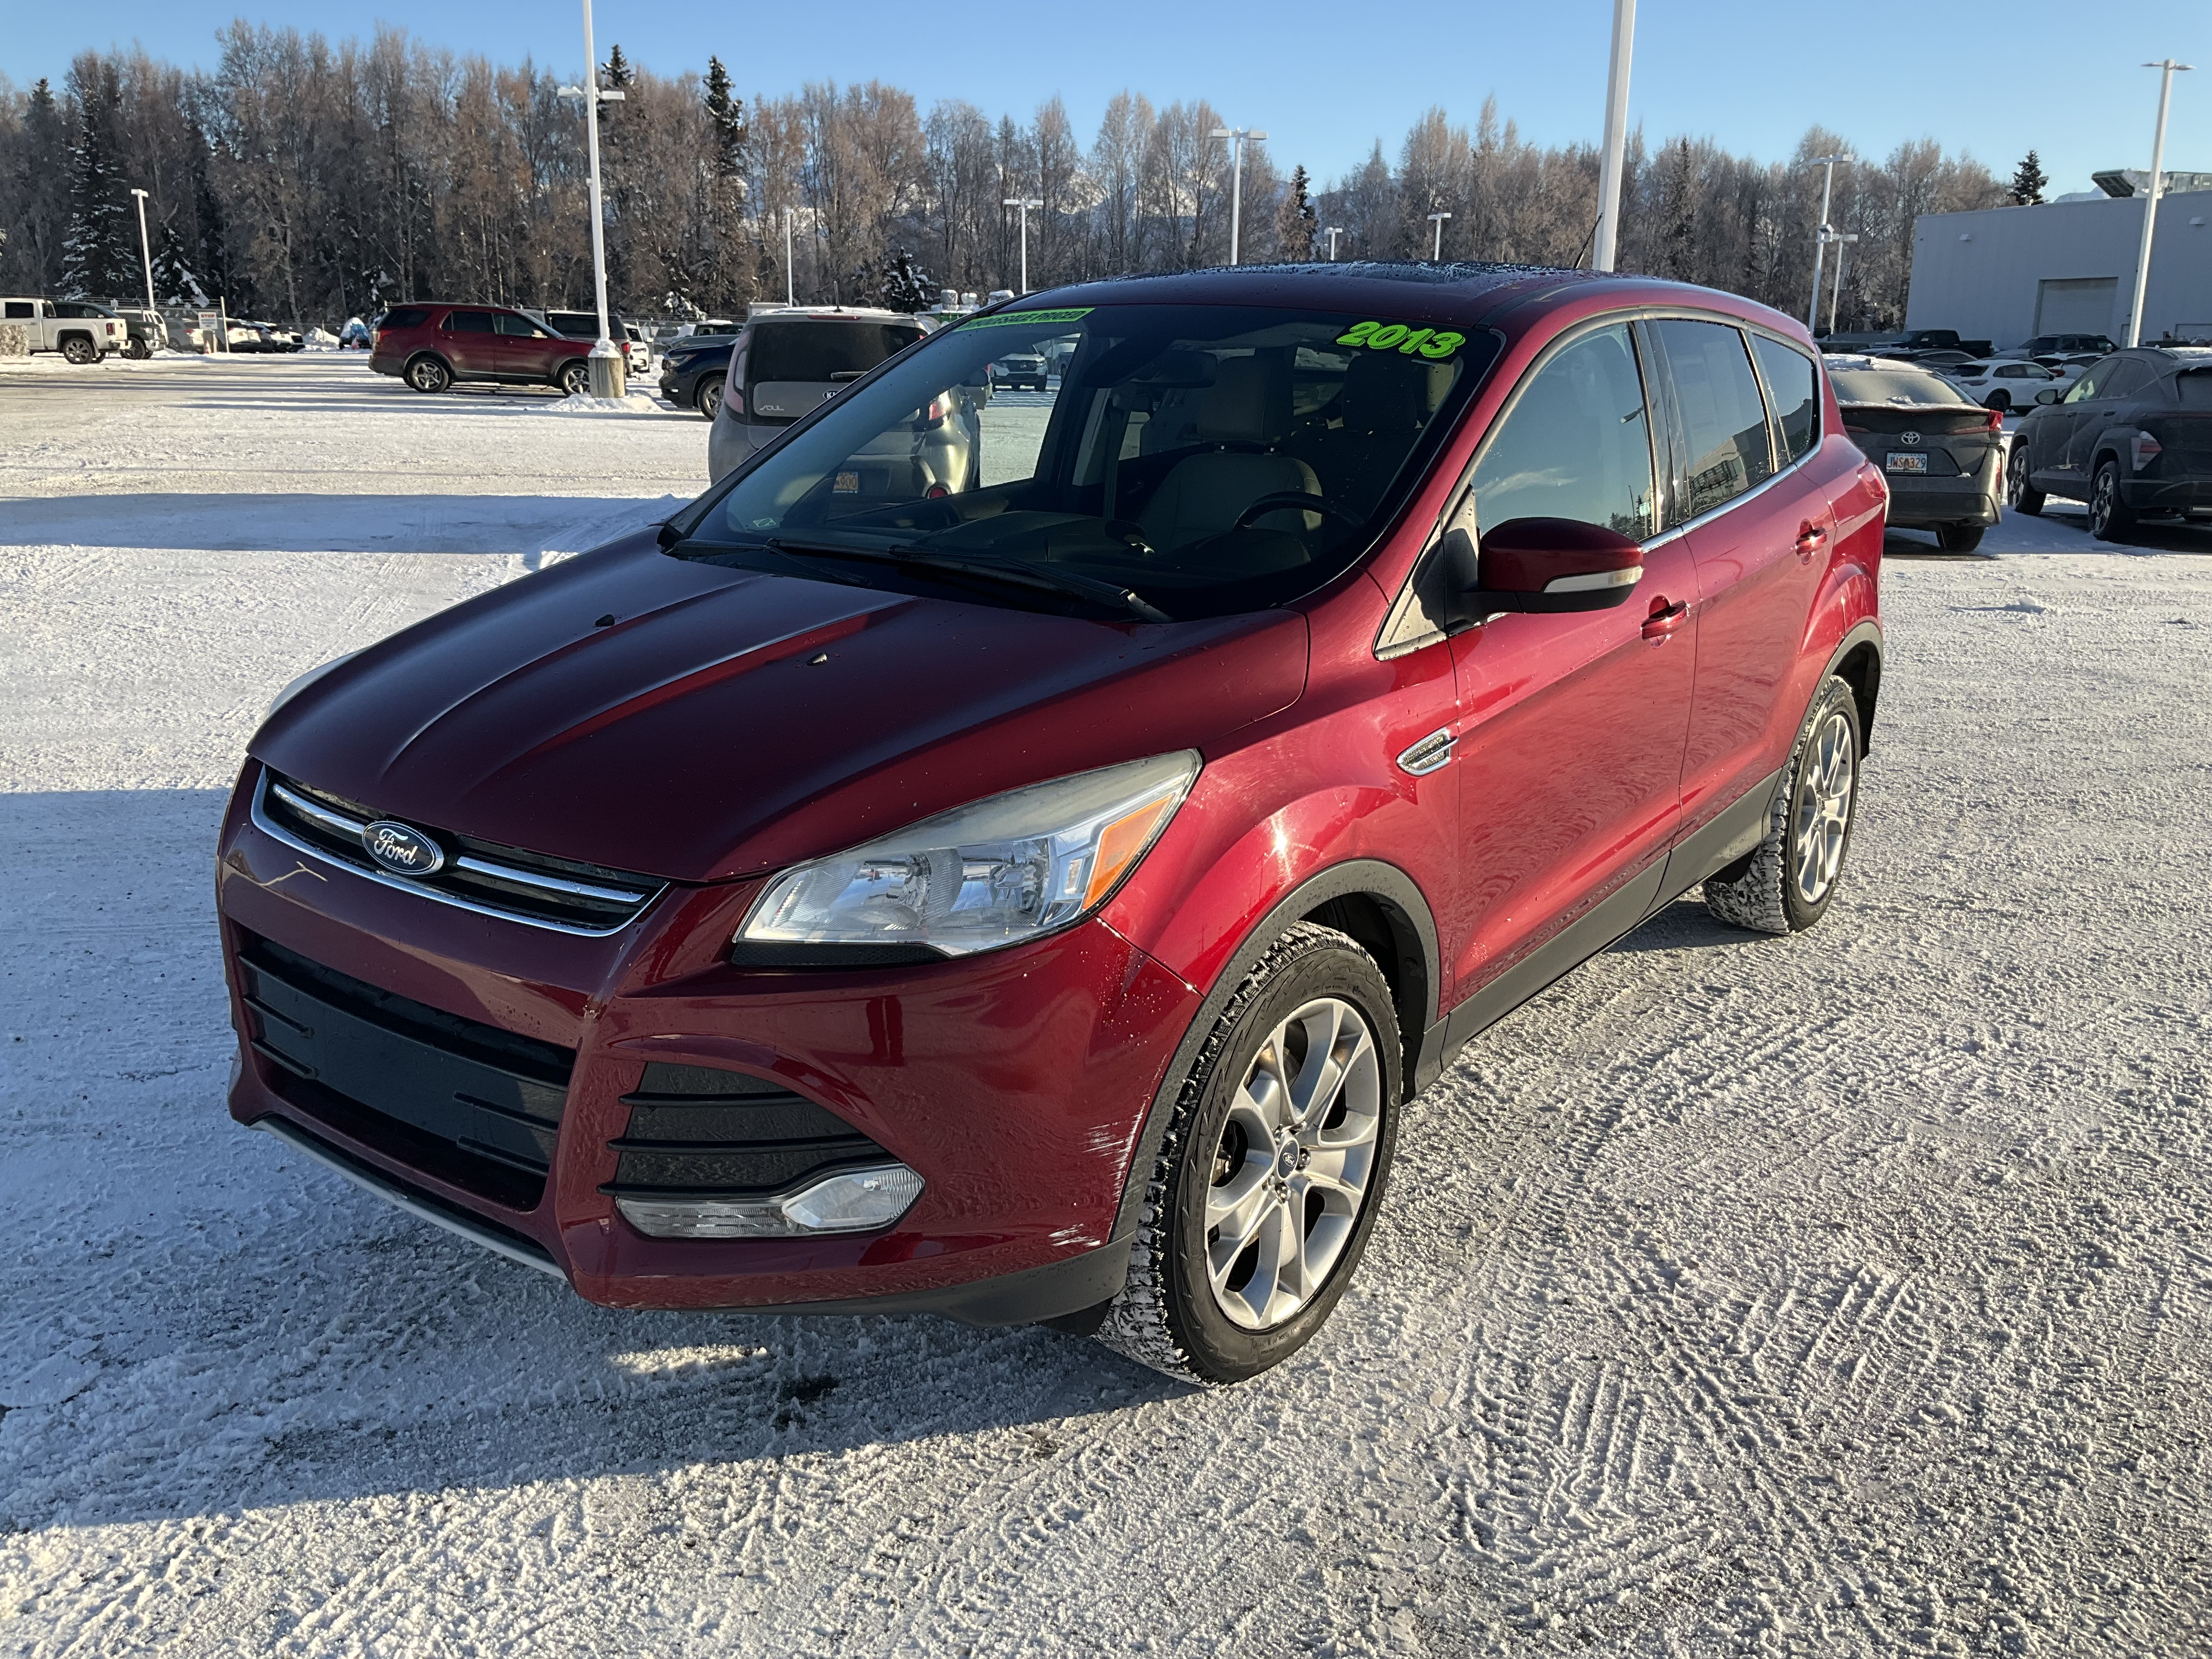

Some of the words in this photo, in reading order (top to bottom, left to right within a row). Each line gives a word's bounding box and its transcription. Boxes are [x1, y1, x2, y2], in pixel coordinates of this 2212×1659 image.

[1336, 321, 1466, 358] 2013
[1909, 458, 1927, 469] 329
[374, 828, 419, 865] Ford
